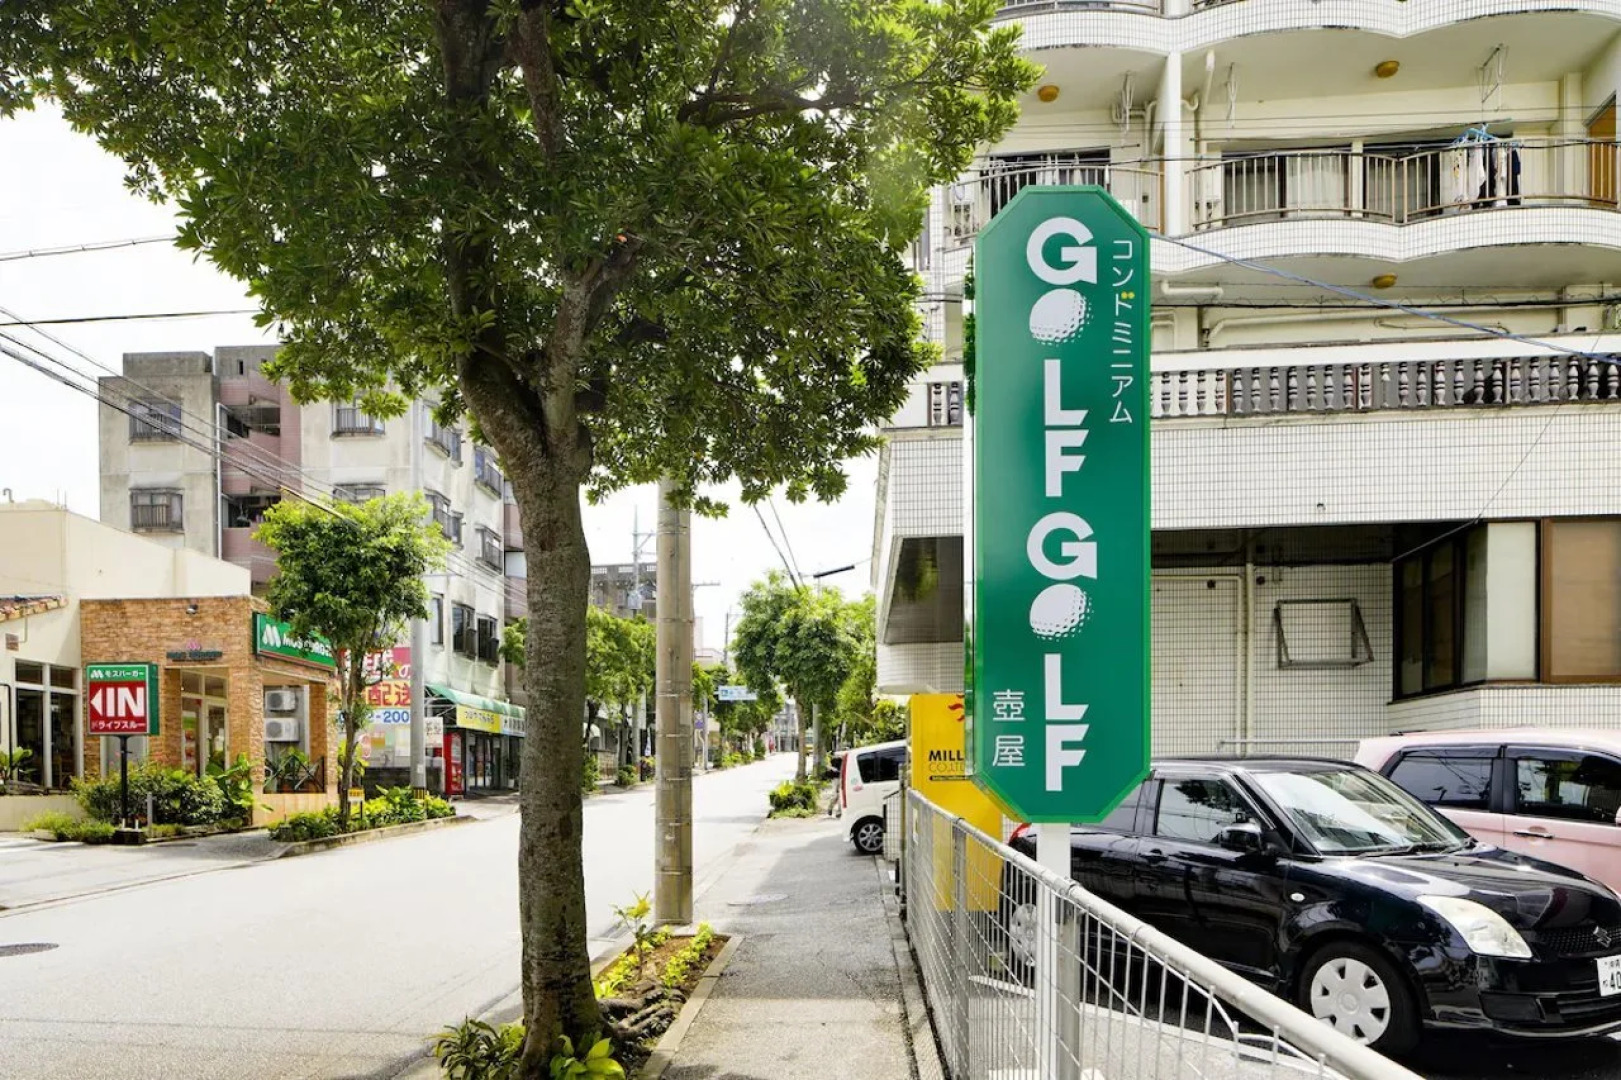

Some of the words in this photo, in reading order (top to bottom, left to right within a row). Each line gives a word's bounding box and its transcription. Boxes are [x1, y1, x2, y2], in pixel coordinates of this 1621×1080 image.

[1109, 239, 1135, 424] コンドミニアム
[106, 686, 145, 717] IN
